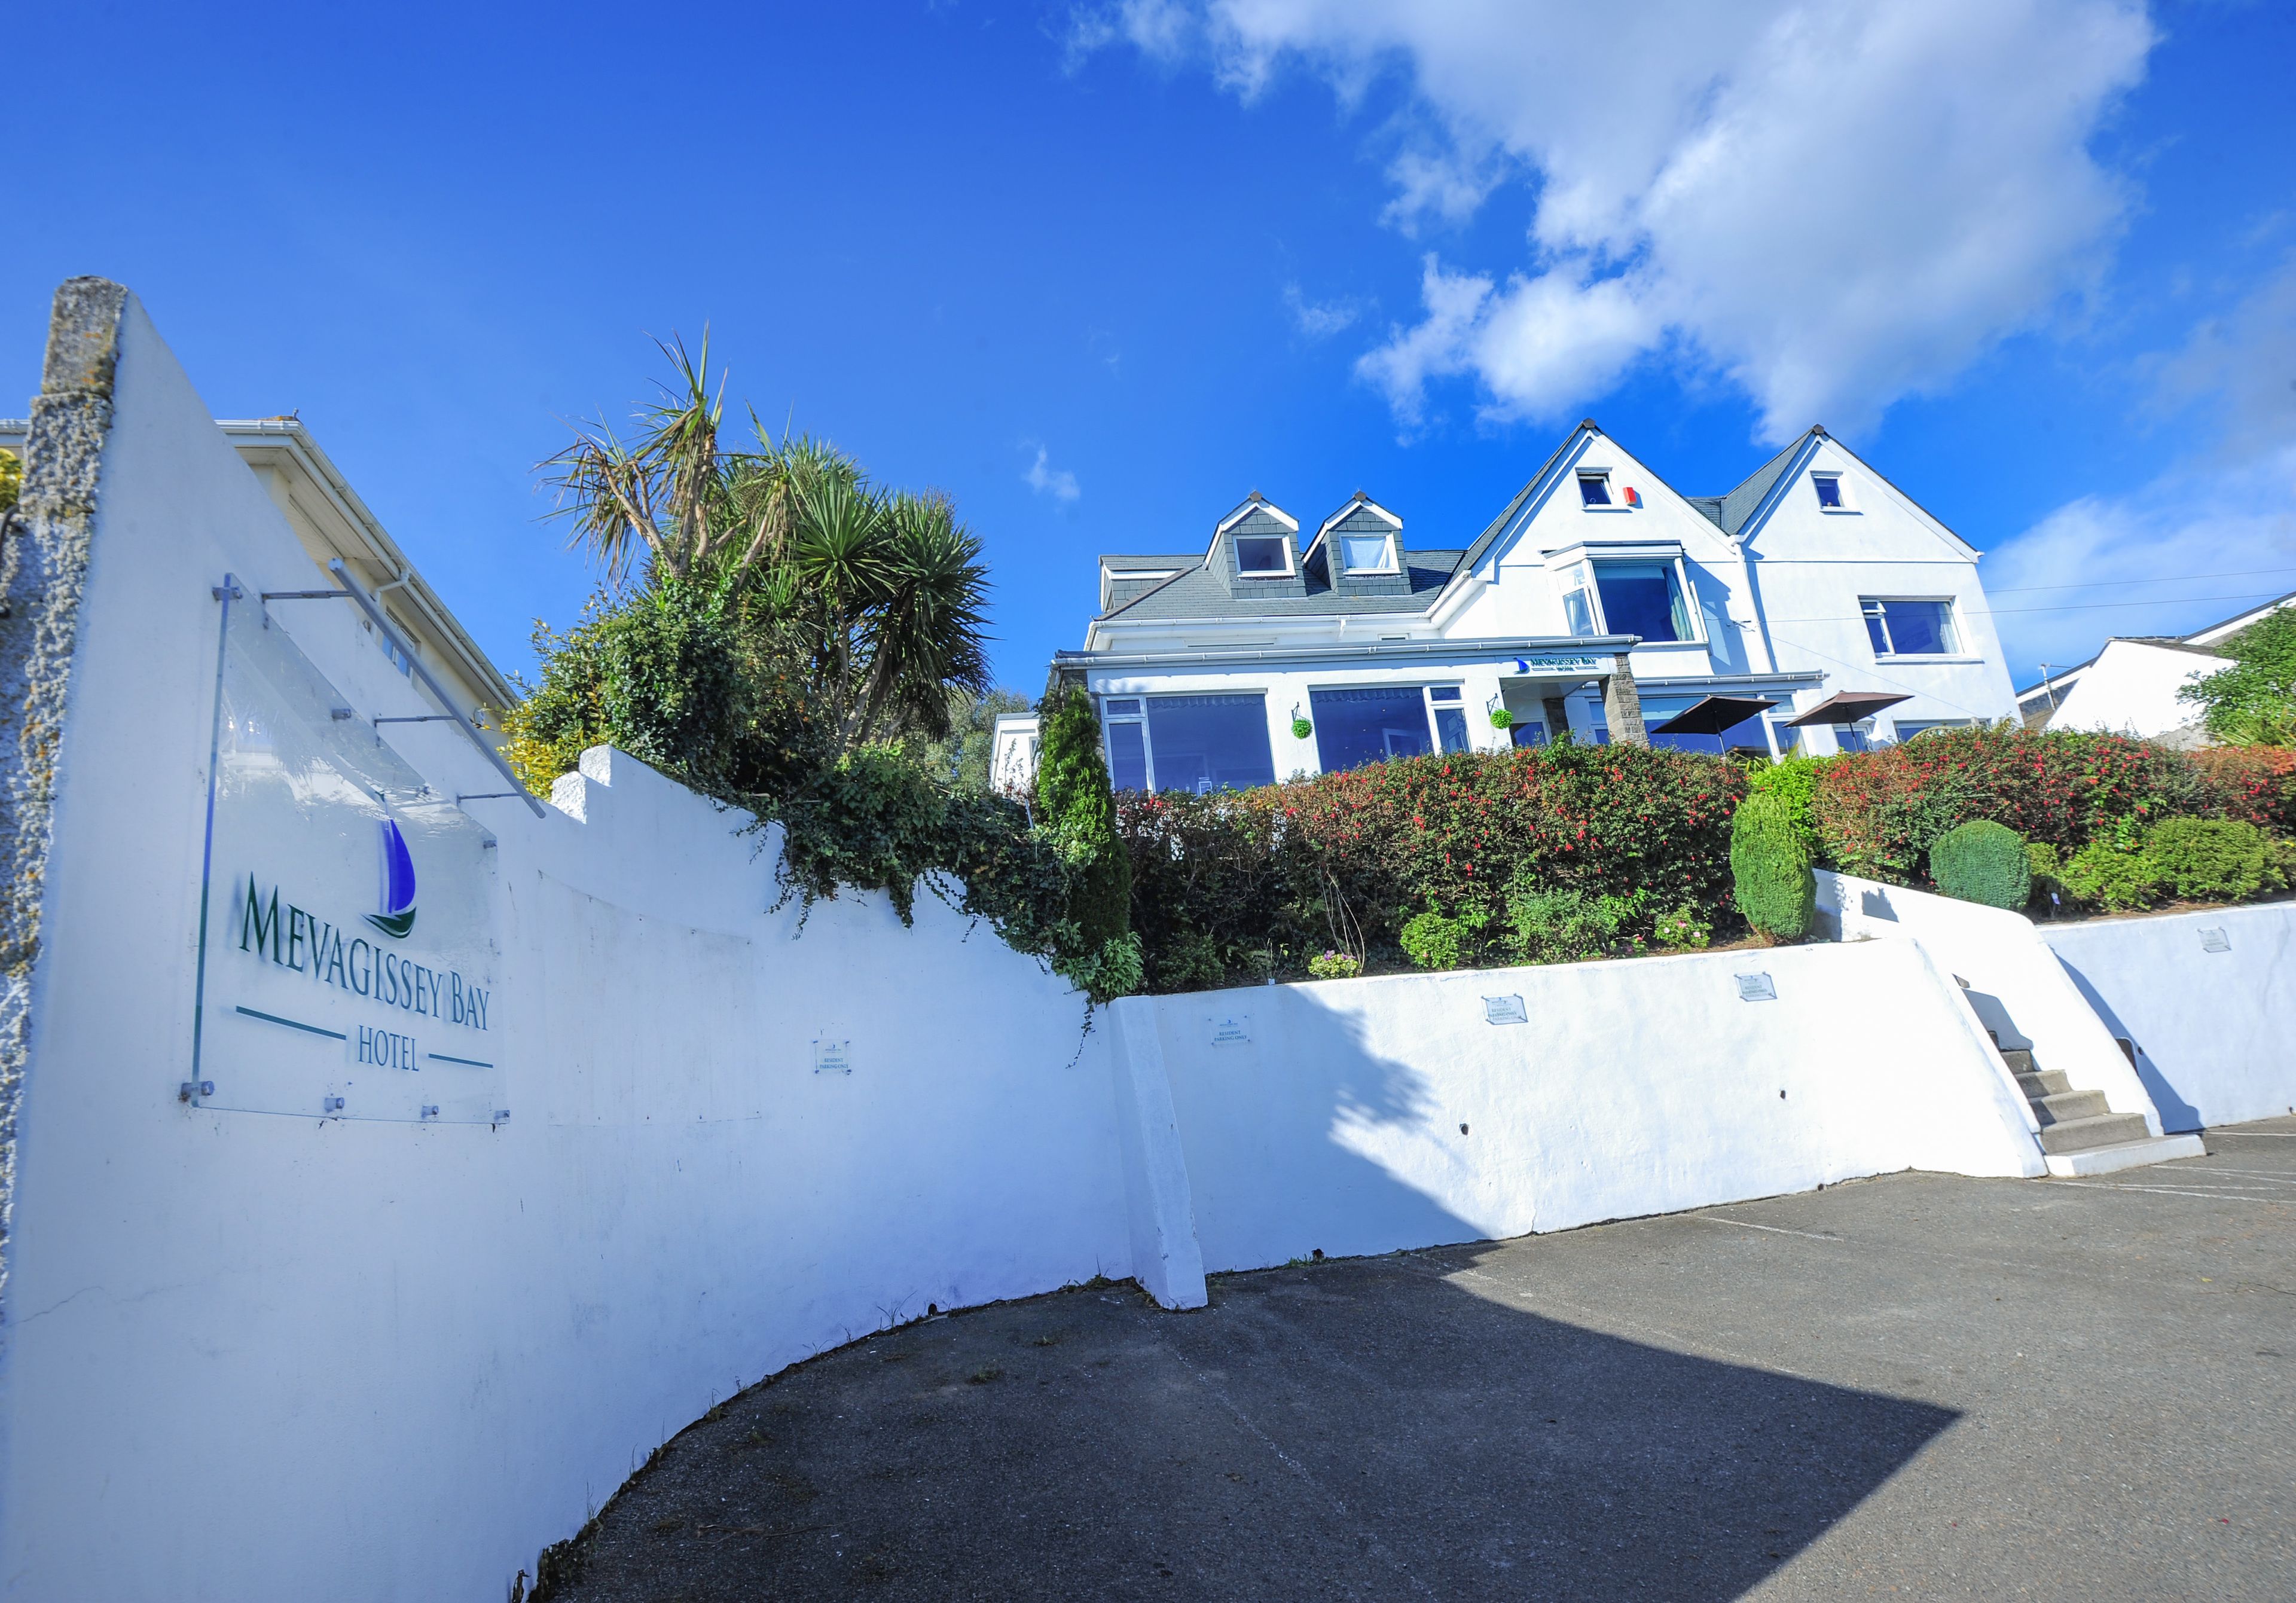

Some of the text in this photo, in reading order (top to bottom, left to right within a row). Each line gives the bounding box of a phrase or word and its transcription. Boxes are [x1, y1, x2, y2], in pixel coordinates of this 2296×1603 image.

[1580, 657, 1597, 665] BAY
[239, 871, 490, 1031] MEVAGISSEY BAY
[358, 1024, 419, 1072] HOTEL
